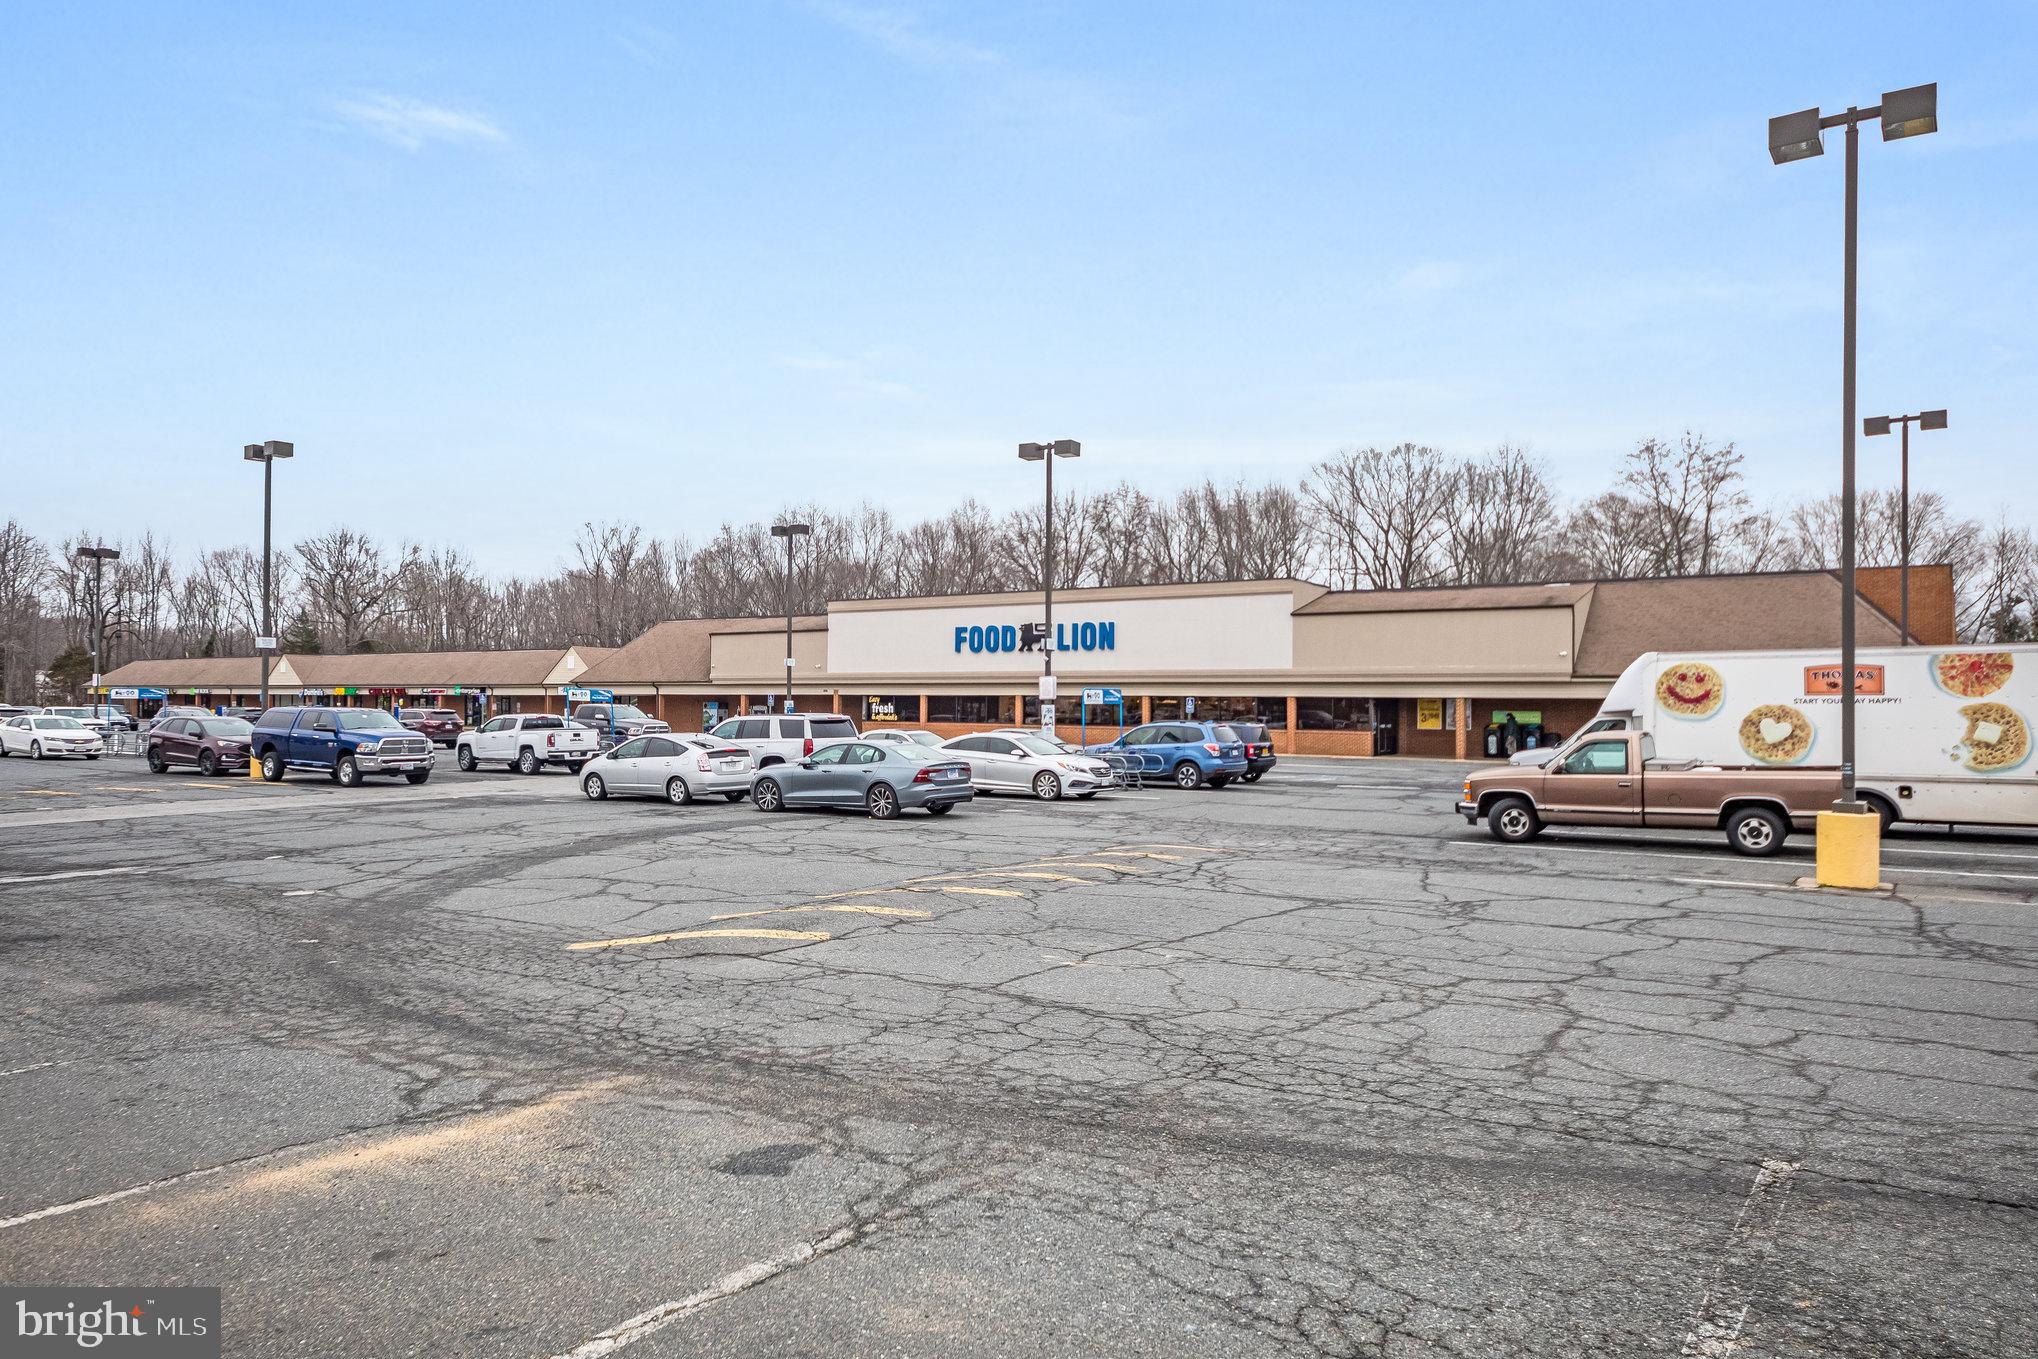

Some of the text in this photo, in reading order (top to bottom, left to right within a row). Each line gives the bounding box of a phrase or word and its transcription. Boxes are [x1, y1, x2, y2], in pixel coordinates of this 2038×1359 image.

[955, 621, 1114, 653] FOOD LION
[1812, 670, 1875, 680] THOAS
[871, 702, 895, 713] fresh
